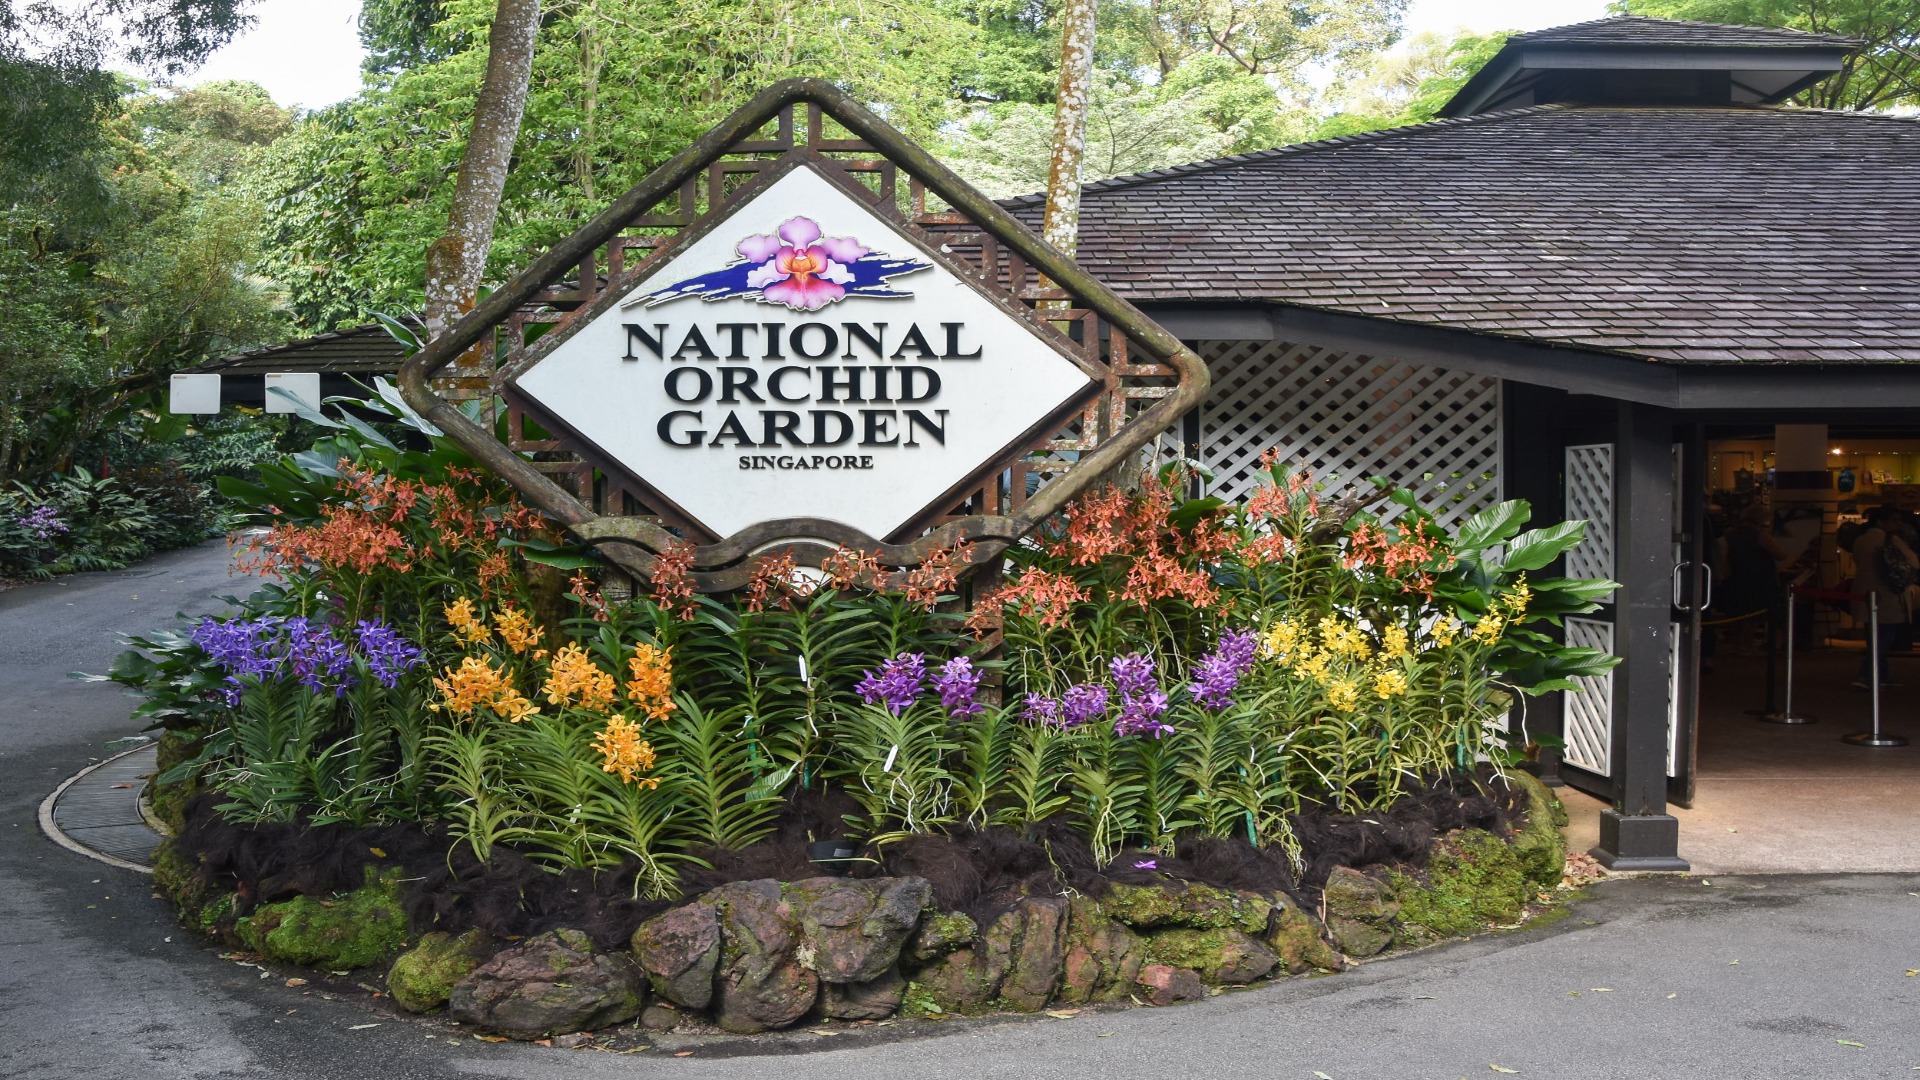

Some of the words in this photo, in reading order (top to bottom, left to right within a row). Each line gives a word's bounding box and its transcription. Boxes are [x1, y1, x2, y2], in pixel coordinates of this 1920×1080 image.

[621, 322, 983, 361] NATIONAL
[664, 366, 942, 404] ORCHID
[657, 410, 949, 447] GARDEN
[739, 455, 874, 470] SINGAPORE
